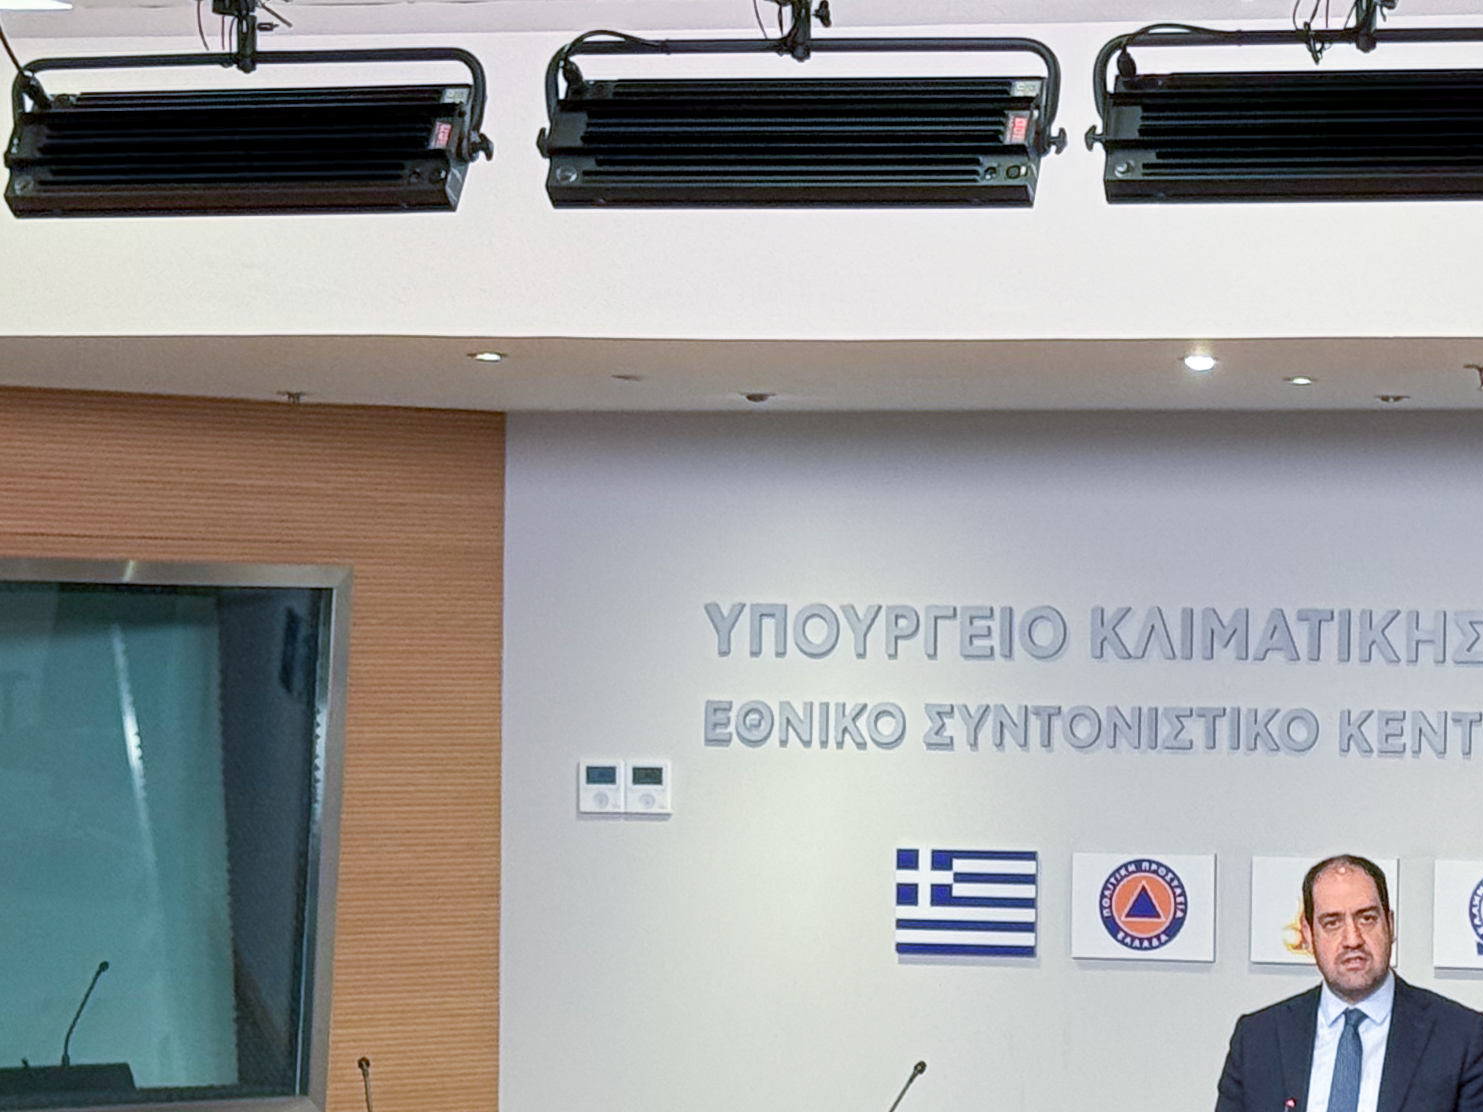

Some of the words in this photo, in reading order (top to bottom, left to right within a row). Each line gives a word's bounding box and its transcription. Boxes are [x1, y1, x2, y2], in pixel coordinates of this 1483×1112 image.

[703, 602, 1068, 660] ΥΠΟΥΡΓΕΙΟ
[703, 700, 907, 749] ΕΘΝΙΚΟ
[923, 703, 1319, 753] ΣΥΝΤΟΝΙΣΤΙΚΟ
[1102, 864, 1136, 917] ΠΟΛΙΤΙΚΗ
[1142, 861, 1185, 918] ΠΡΟΣΤΑΣΙΑ
